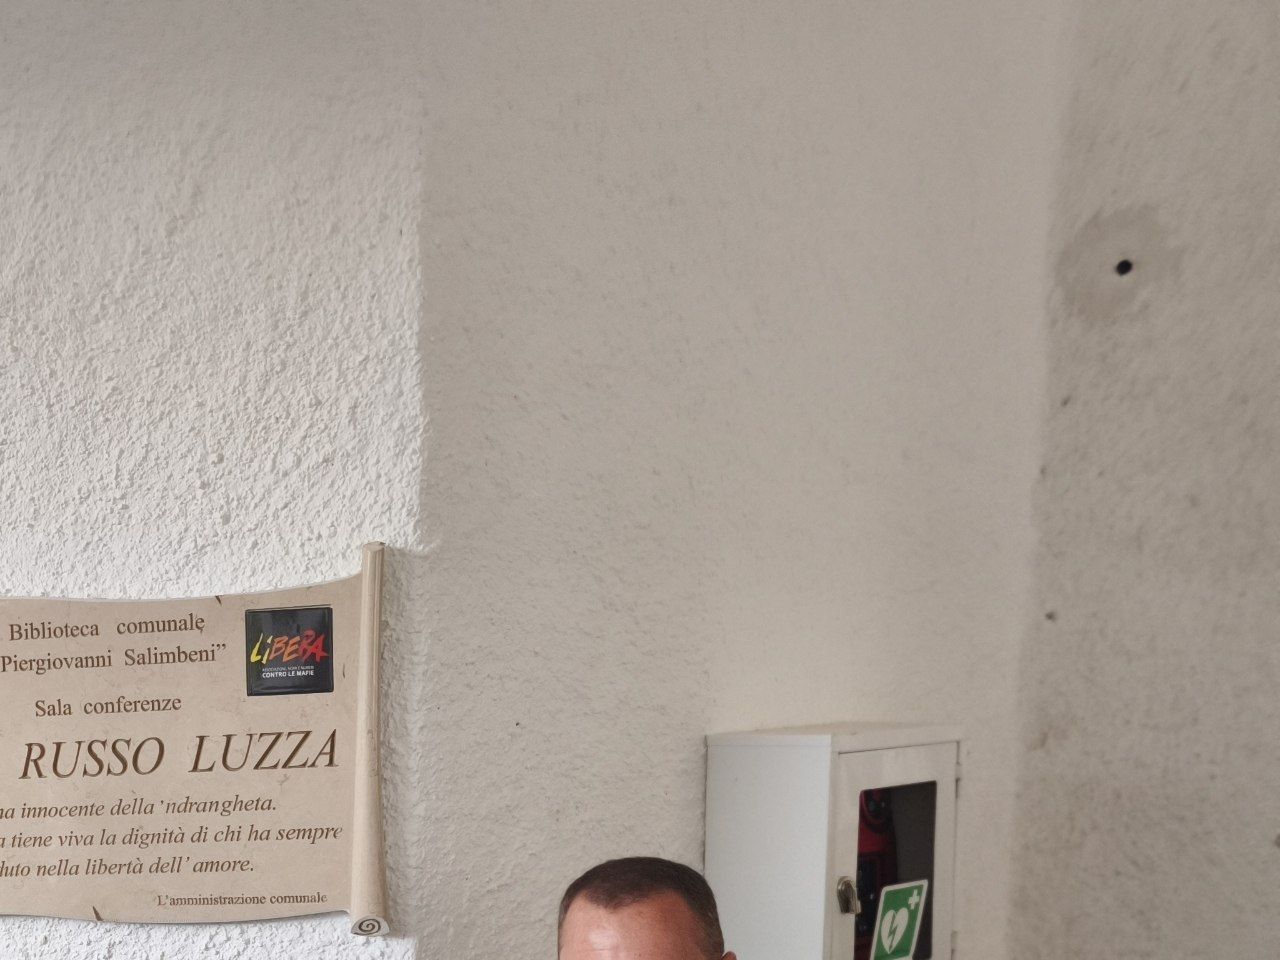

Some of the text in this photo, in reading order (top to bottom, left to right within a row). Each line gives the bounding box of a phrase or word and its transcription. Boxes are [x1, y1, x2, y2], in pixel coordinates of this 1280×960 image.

[9, 613, 206, 642] Biblioteca comunale
[124, 643, 227, 667] Salimbeni”
[262, 671, 287, 679] CONTRO
[35, 695, 182, 718] Sala conferenze
[18, 736, 165, 780] RUSSO
[188, 728, 340, 773] LUZZA
[20, 801, 105, 819] innocente
[109, 797, 155, 816] della
[160, 794, 277, 817] 'ndrangheta.
[11, 832, 53, 849] tiene
[58, 829, 95, 848] viva
[99, 828, 117, 847] la
[121, 825, 186, 850] dignità
[190, 825, 209, 844] di
[213, 825, 242, 843] chi
[247, 824, 271, 841] ha
[275, 826, 344, 845] sempre
[35, 858, 80, 877] nella
[85, 857, 144, 876] libertà
[157, 891, 328, 906] L’amministrazione comunale
